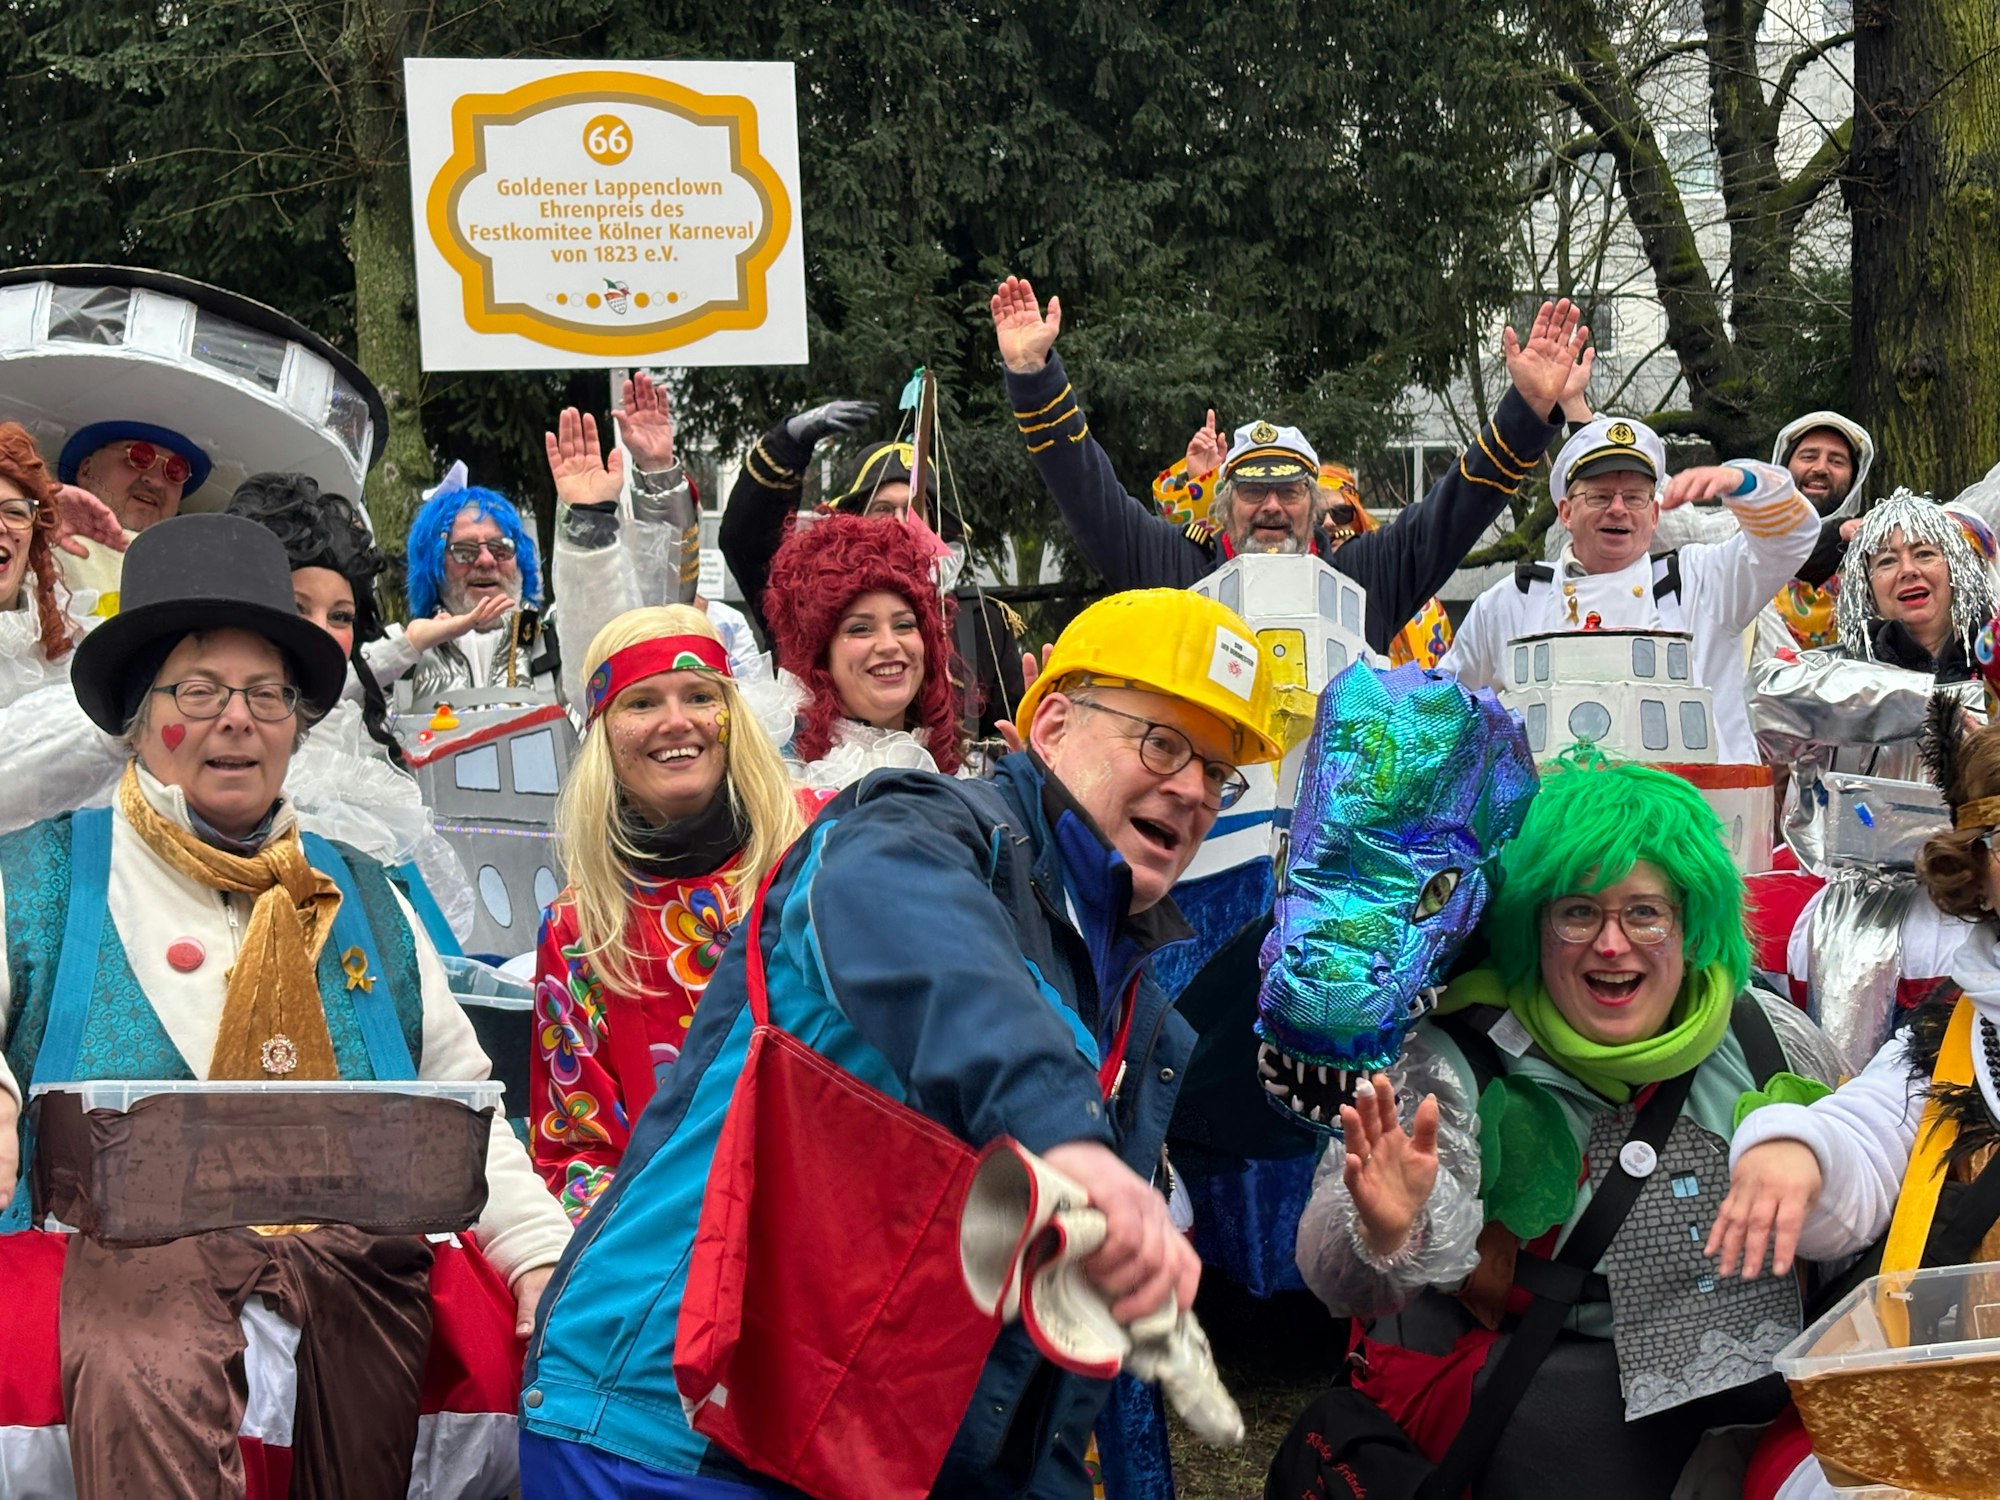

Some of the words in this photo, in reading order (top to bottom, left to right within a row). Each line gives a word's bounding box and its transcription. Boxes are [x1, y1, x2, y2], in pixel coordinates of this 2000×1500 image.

[588, 125, 628, 155] 66
[497, 178, 587, 196] Goldener
[594, 178, 723, 201] Lappenclown
[539, 199, 644, 222] Ehrenpreis
[650, 199, 684, 218] des
[468, 224, 592, 241] Festkomitee
[598, 222, 662, 241] Kölner
[668, 222, 754, 240] Karneval
[551, 247, 588, 263] von
[594, 245, 638, 263] 1823
[643, 246, 679, 263] e.V.
